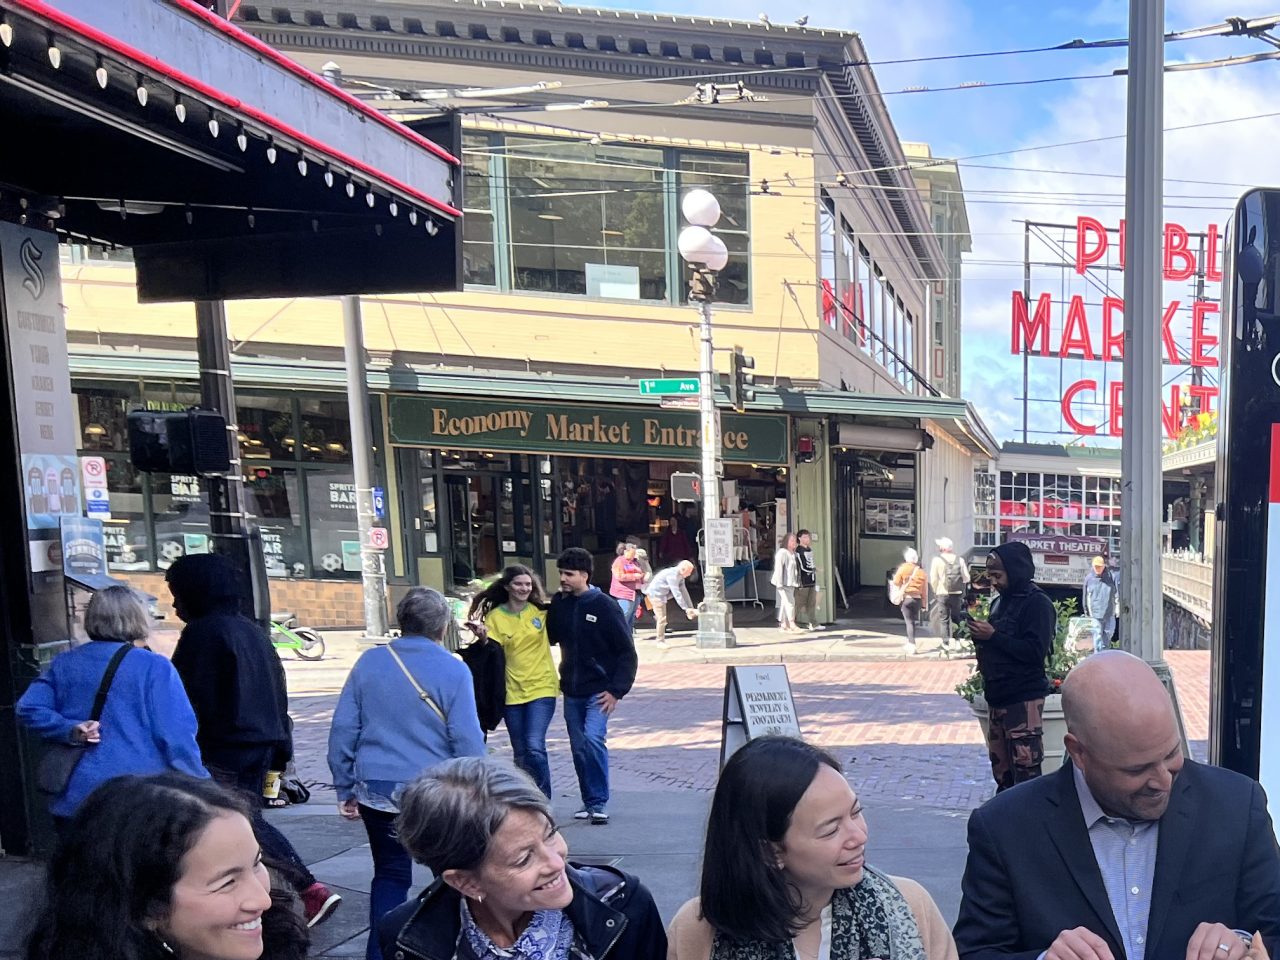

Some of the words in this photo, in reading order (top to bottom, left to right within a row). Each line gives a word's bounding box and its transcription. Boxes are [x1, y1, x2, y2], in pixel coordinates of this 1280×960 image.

[1076, 215, 1223, 282] PBL
[679, 381, 695, 390] Ave
[431, 407, 534, 438] Economy
[545, 413, 632, 445] Market
[642, 417, 749, 450] Entrace
[170, 482, 200, 496] BAR
[1058, 541, 1102, 553] THEATER
[749, 703, 781, 713] JEWELRY
